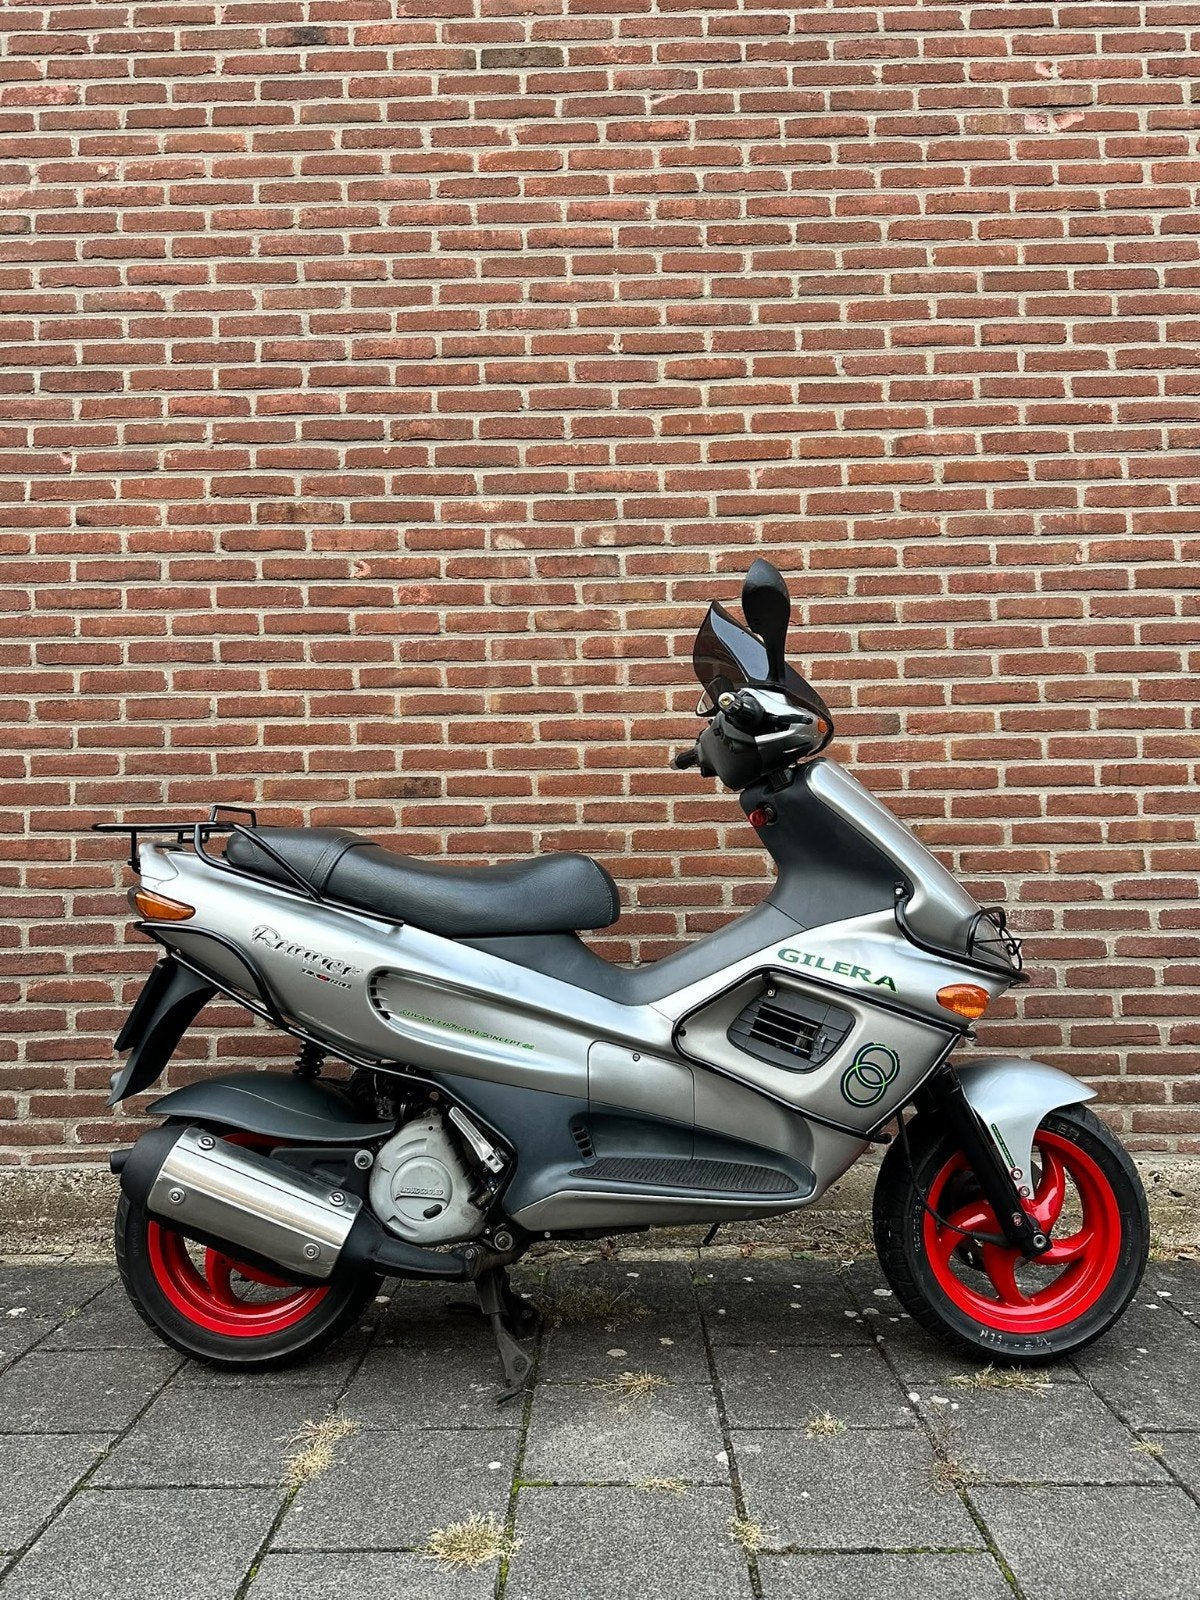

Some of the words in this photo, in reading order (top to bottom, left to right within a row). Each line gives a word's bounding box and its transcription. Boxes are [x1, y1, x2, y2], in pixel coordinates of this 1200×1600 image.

[251, 924, 363, 978] Runner
[777, 947, 898, 993] GILERA
[480, 1031, 521, 1047] CONCEPT
